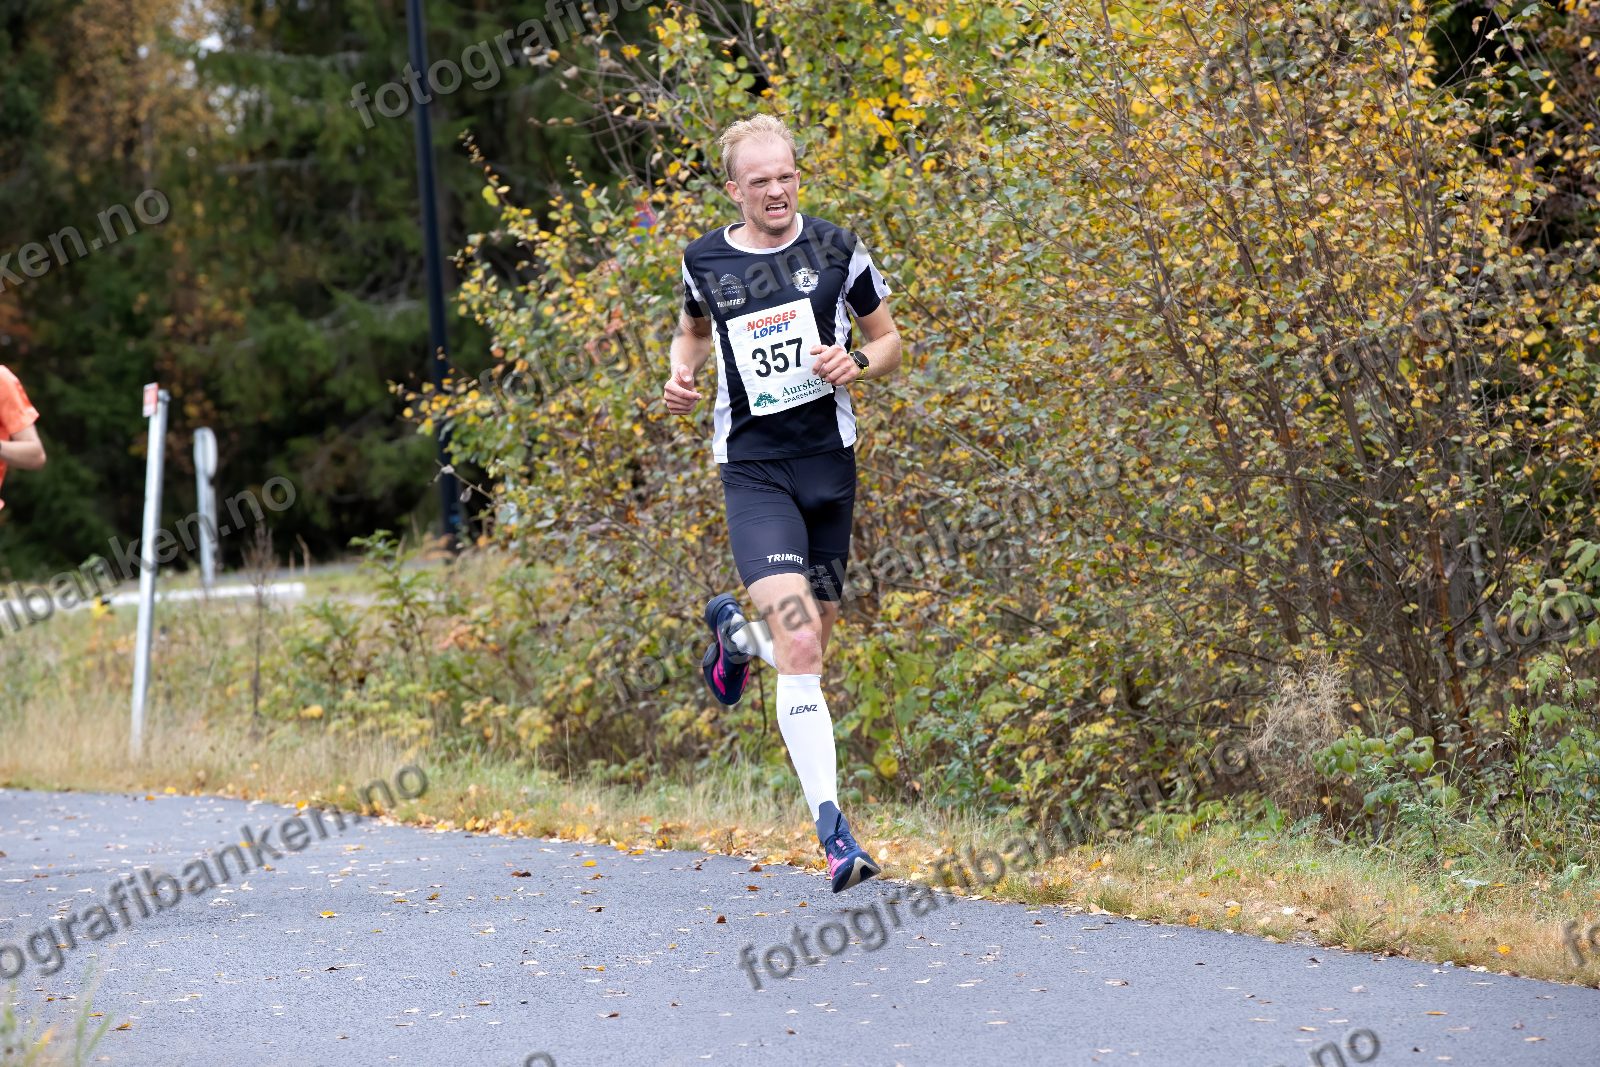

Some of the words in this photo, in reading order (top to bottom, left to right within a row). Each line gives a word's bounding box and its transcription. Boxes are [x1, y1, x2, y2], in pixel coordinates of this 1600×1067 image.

[717, 298, 746, 308] TRIMTEX
[747, 310, 796, 331] NORGES
[753, 321, 790, 339] LØPET
[752, 337, 802, 378] 357
[766, 553, 804, 565] TRIMTEX
[790, 704, 817, 715] LENZ
